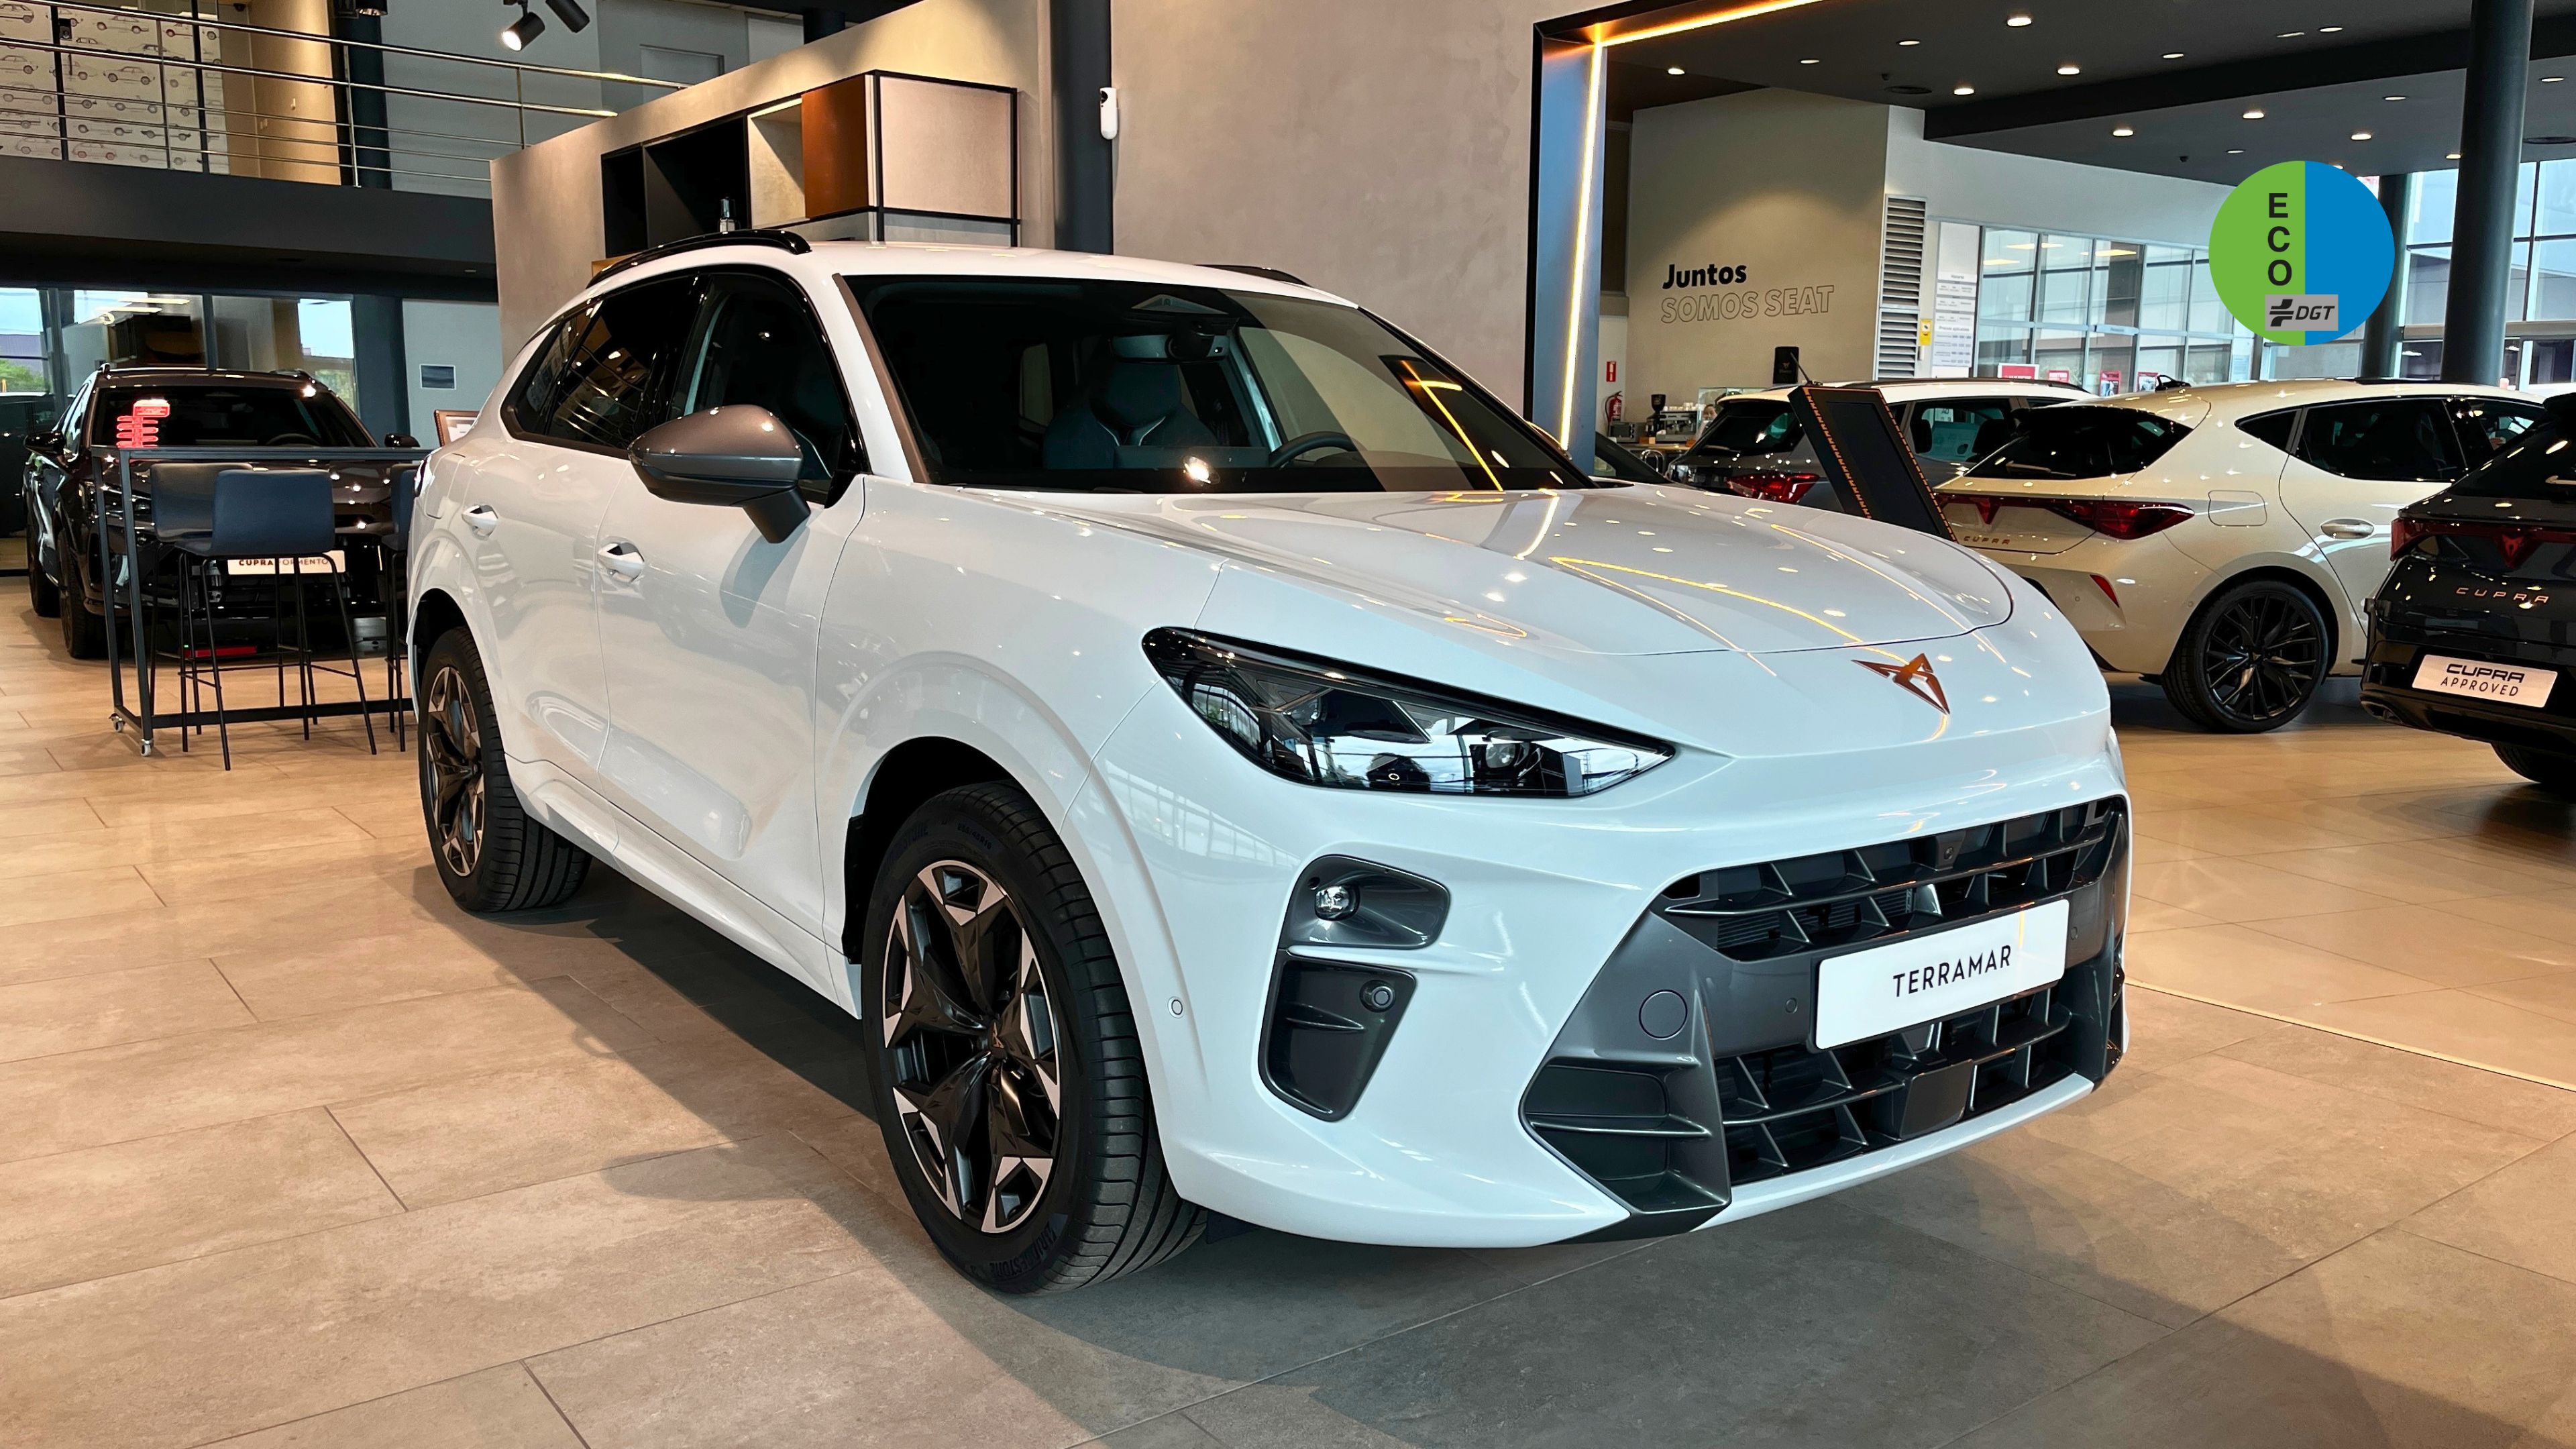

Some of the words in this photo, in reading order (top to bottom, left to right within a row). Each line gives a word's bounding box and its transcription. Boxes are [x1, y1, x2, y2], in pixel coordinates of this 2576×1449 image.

[1662, 264, 1748, 290] Juntos
[1661, 292, 1759, 324] SOMOS
[1764, 284, 1835, 317] SEAT
[1964, 535, 2010, 545] CUPRA
[2456, 587, 2549, 603] CUPRA
[2446, 663, 2525, 683] CUPRA
[2440, 677, 2519, 696] APPROVED
[1893, 945, 2010, 998] TERRAMAR
